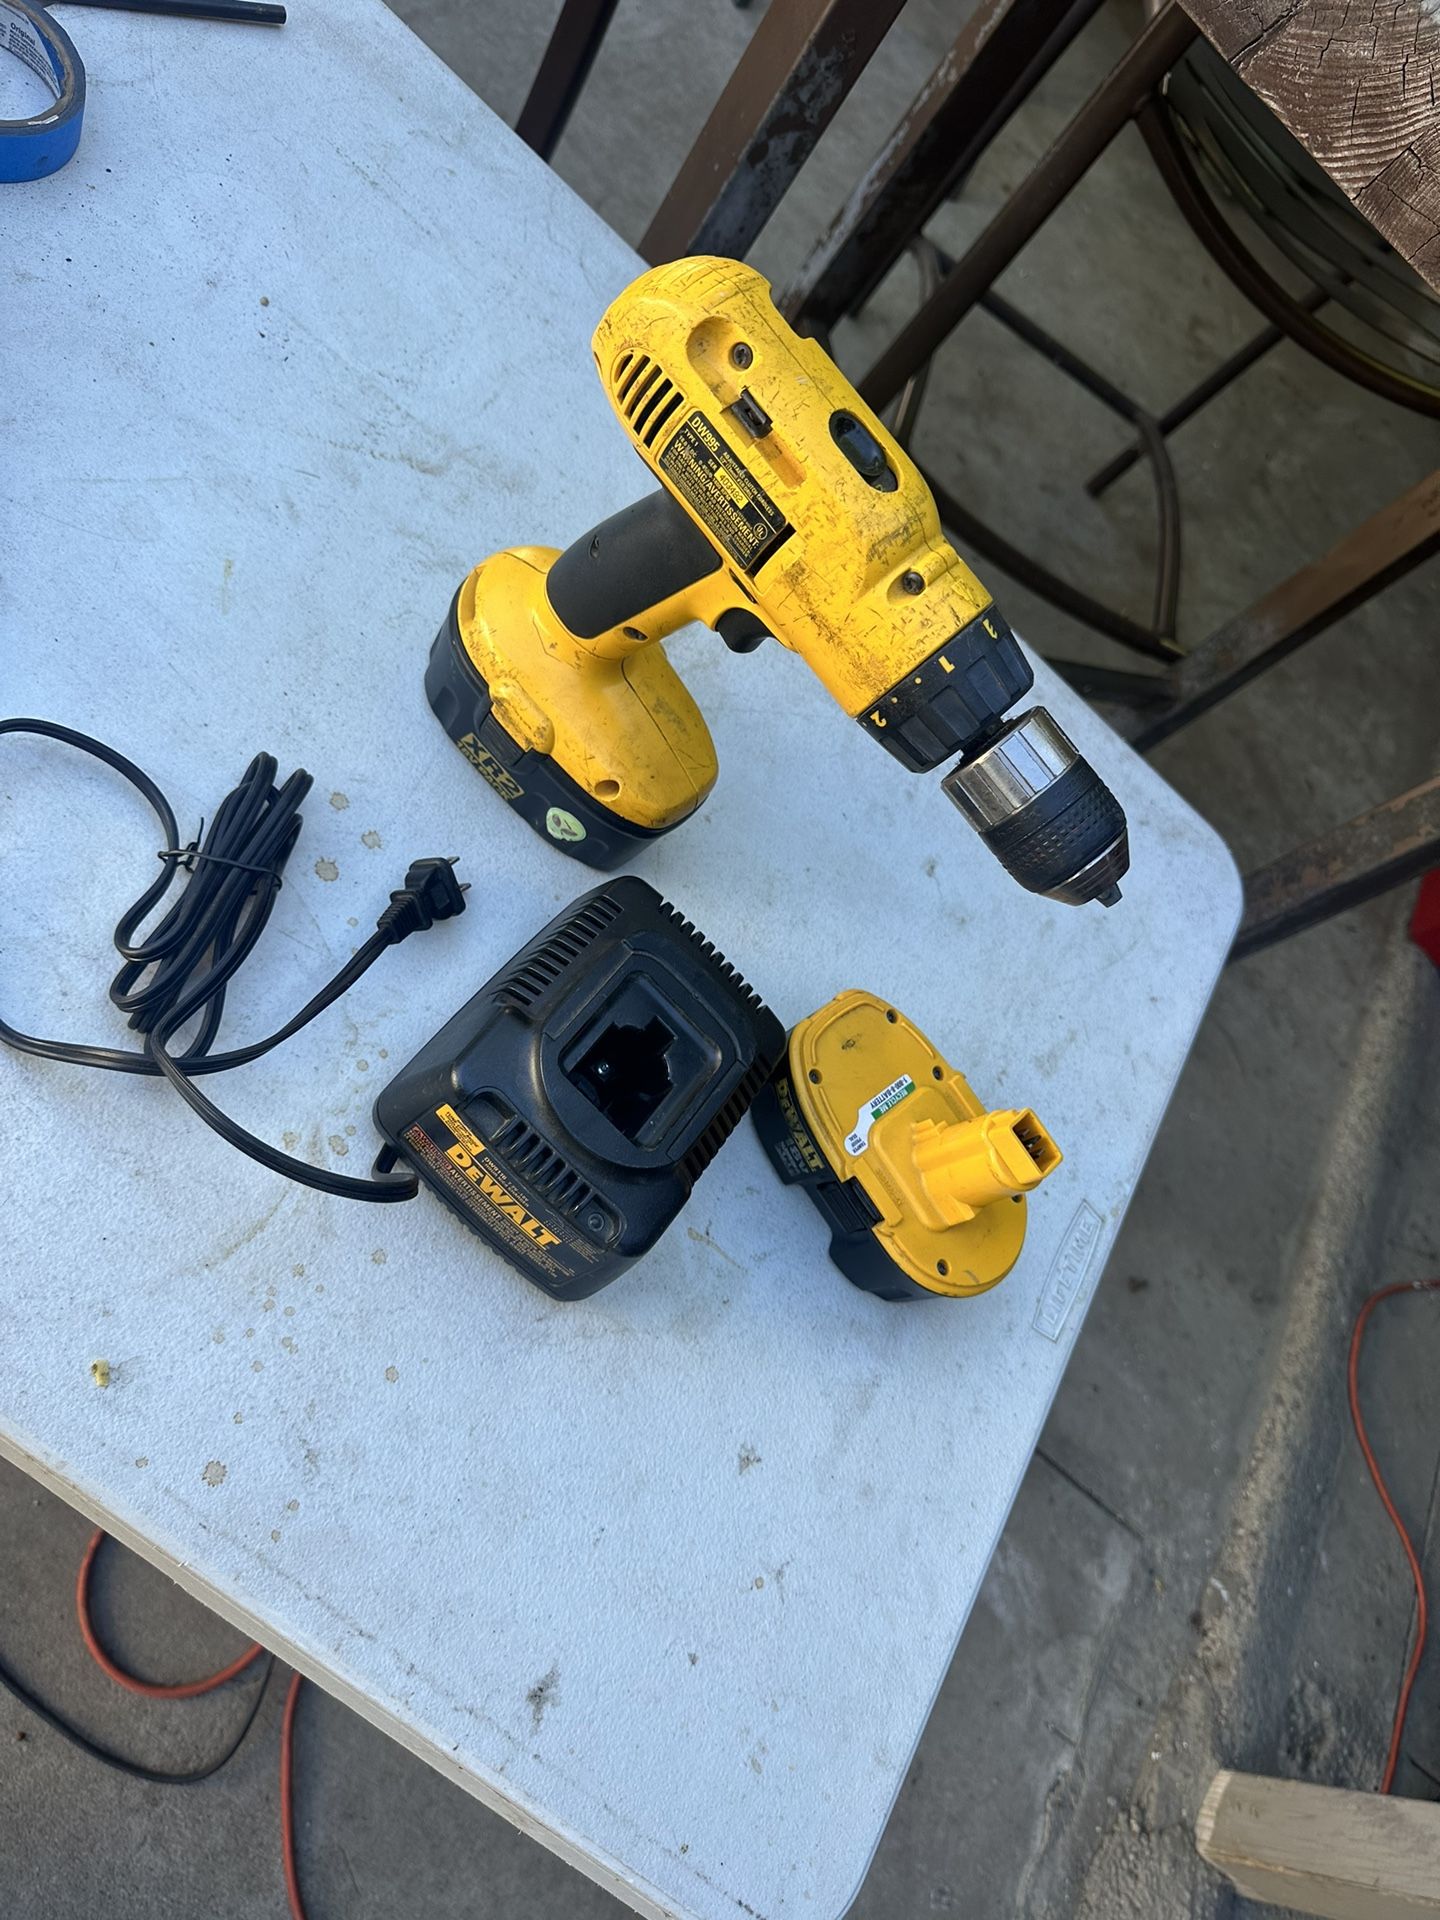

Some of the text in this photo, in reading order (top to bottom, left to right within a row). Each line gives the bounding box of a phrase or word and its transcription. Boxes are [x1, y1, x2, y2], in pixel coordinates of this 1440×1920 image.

[11, 22, 35, 46] Original
[683, 427, 696, 443] TYPE
[690, 416, 720, 452] DW995
[742, 476, 759, 495] CLUTCH
[870, 710, 887, 727] 2
[463, 734, 522, 796] XR2
[877, 1087, 908, 1114] RECYCLE ME
[1043, 1219, 1094, 1324] LIFETIME
